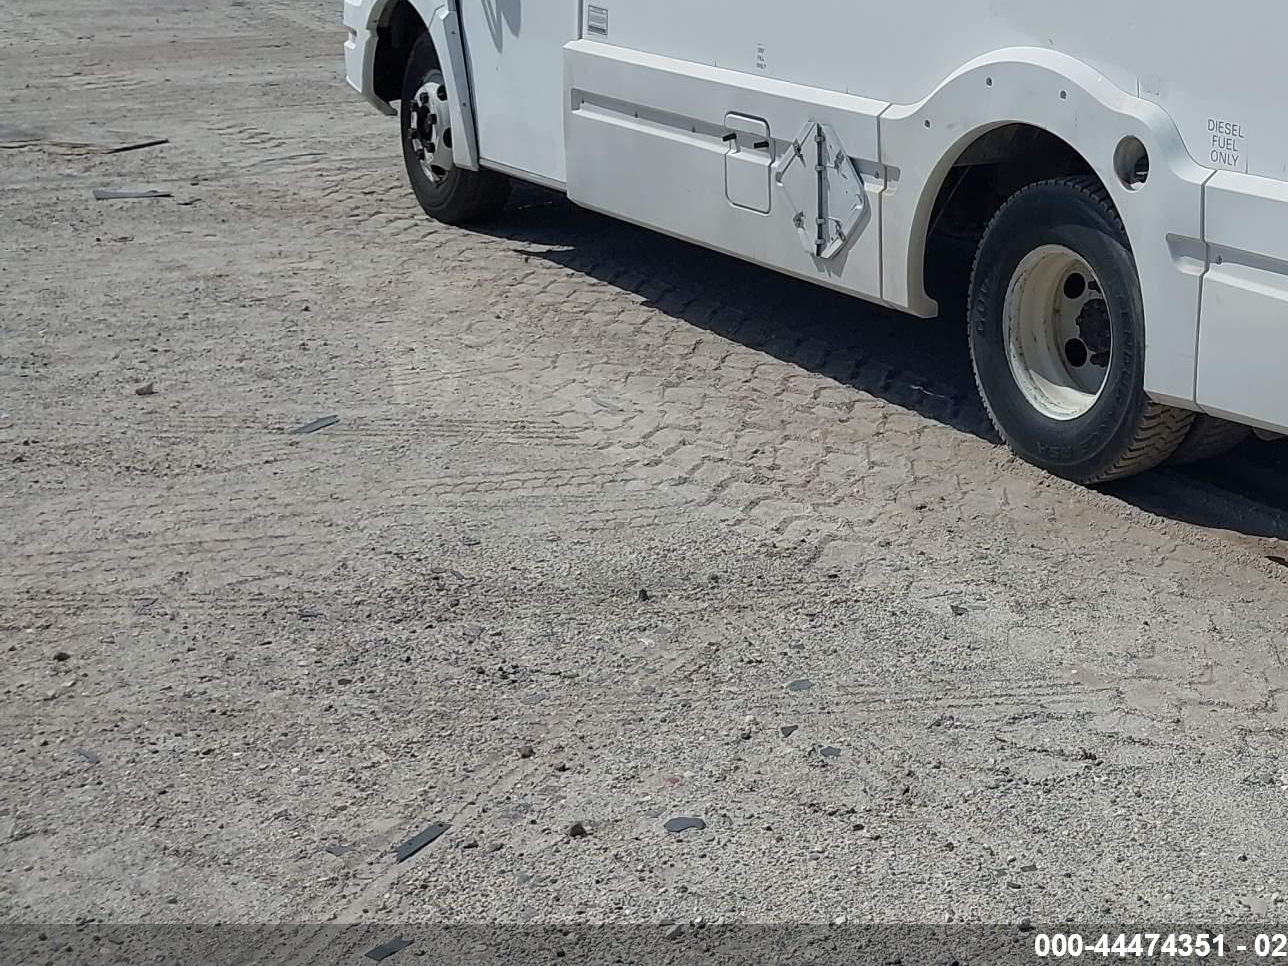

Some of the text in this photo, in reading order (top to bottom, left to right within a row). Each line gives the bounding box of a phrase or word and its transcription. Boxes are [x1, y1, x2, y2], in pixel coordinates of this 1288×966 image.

[1207, 118, 1245, 139] DIESEL
[1212, 134, 1239, 152] FUEL
[1210, 149, 1240, 167] ONLY
